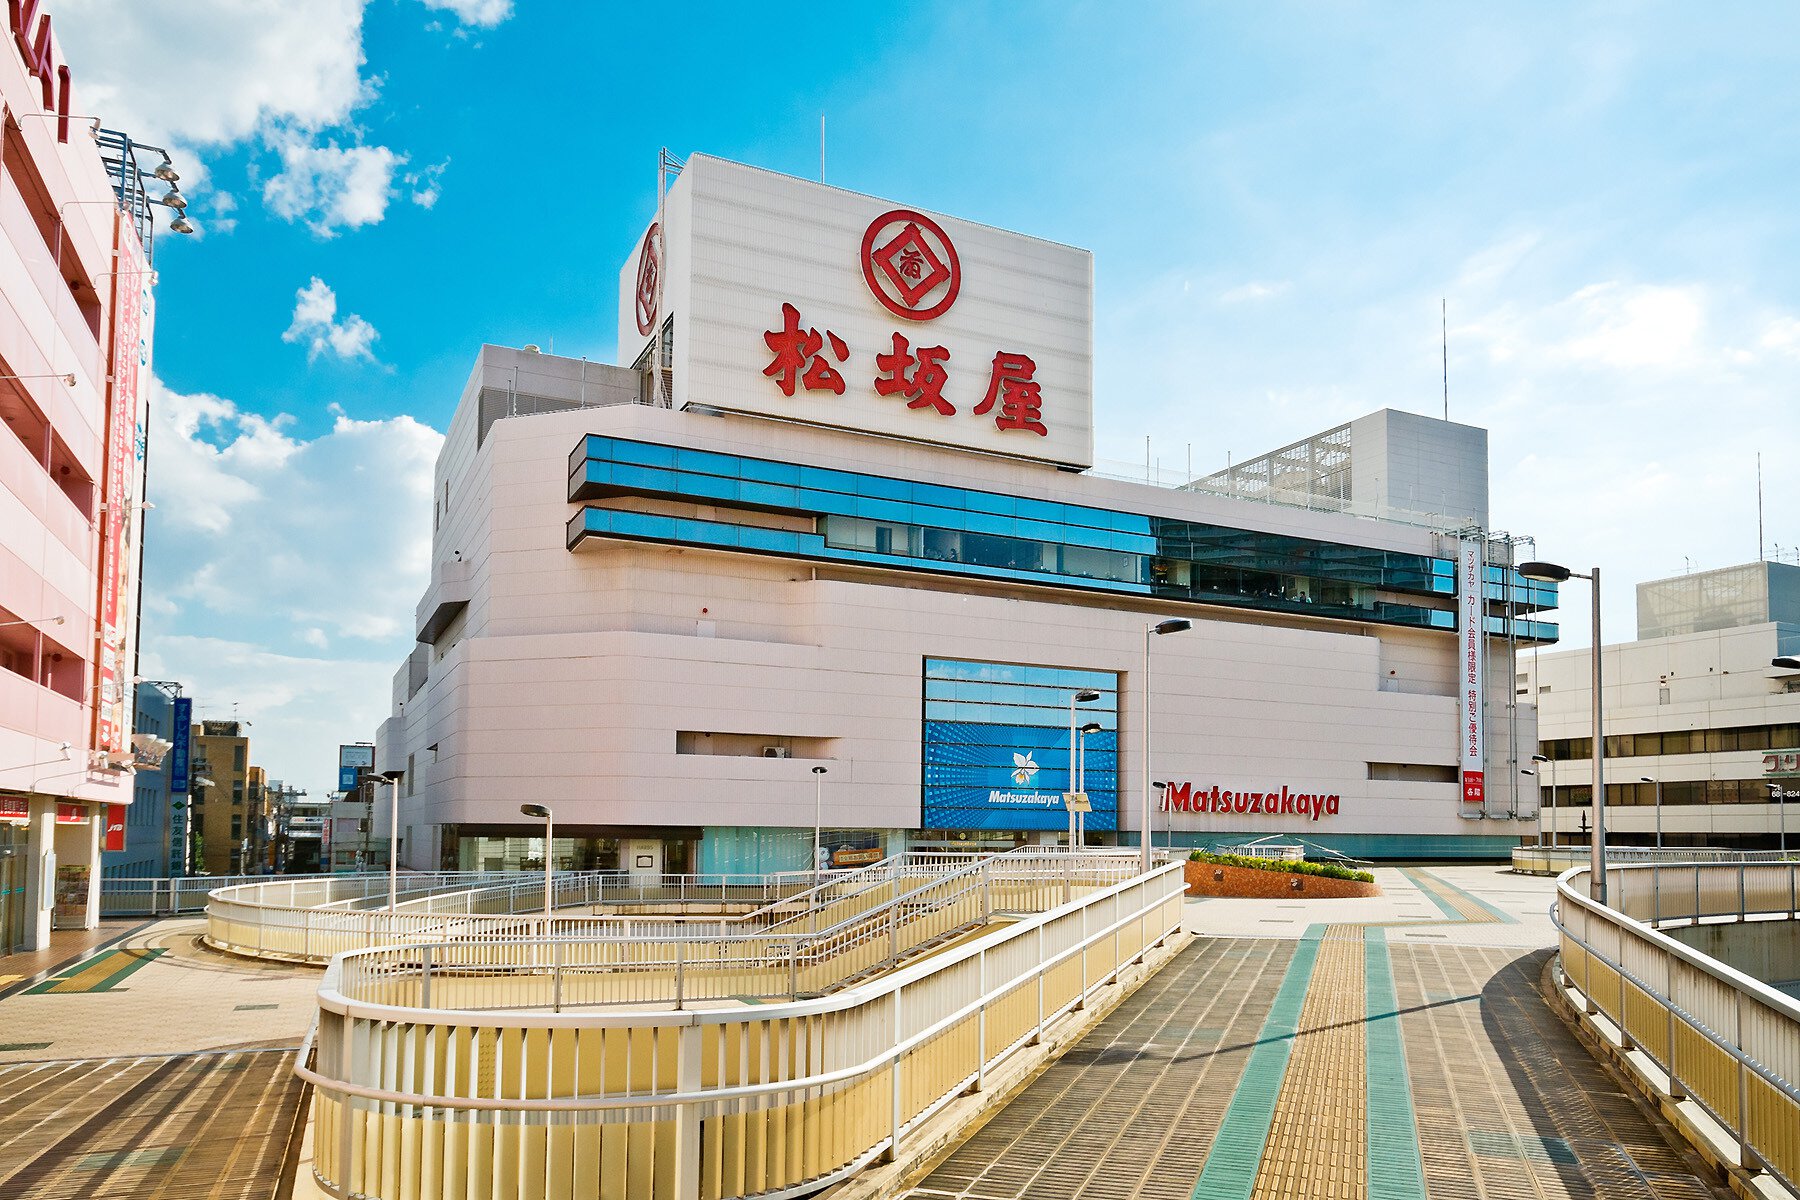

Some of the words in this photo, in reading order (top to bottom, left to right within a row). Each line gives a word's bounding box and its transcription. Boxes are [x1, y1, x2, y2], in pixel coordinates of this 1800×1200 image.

[763, 302, 1048, 437] 松坂屋
[1467, 550, 1475, 588] マツザカヤ
[1467, 595, 1477, 685] カード会員様限定
[988, 790, 1060, 808] Matsuzakaya
[1162, 781, 1340, 822] Matsuzakaya
[107, 824, 124, 832] JTB
